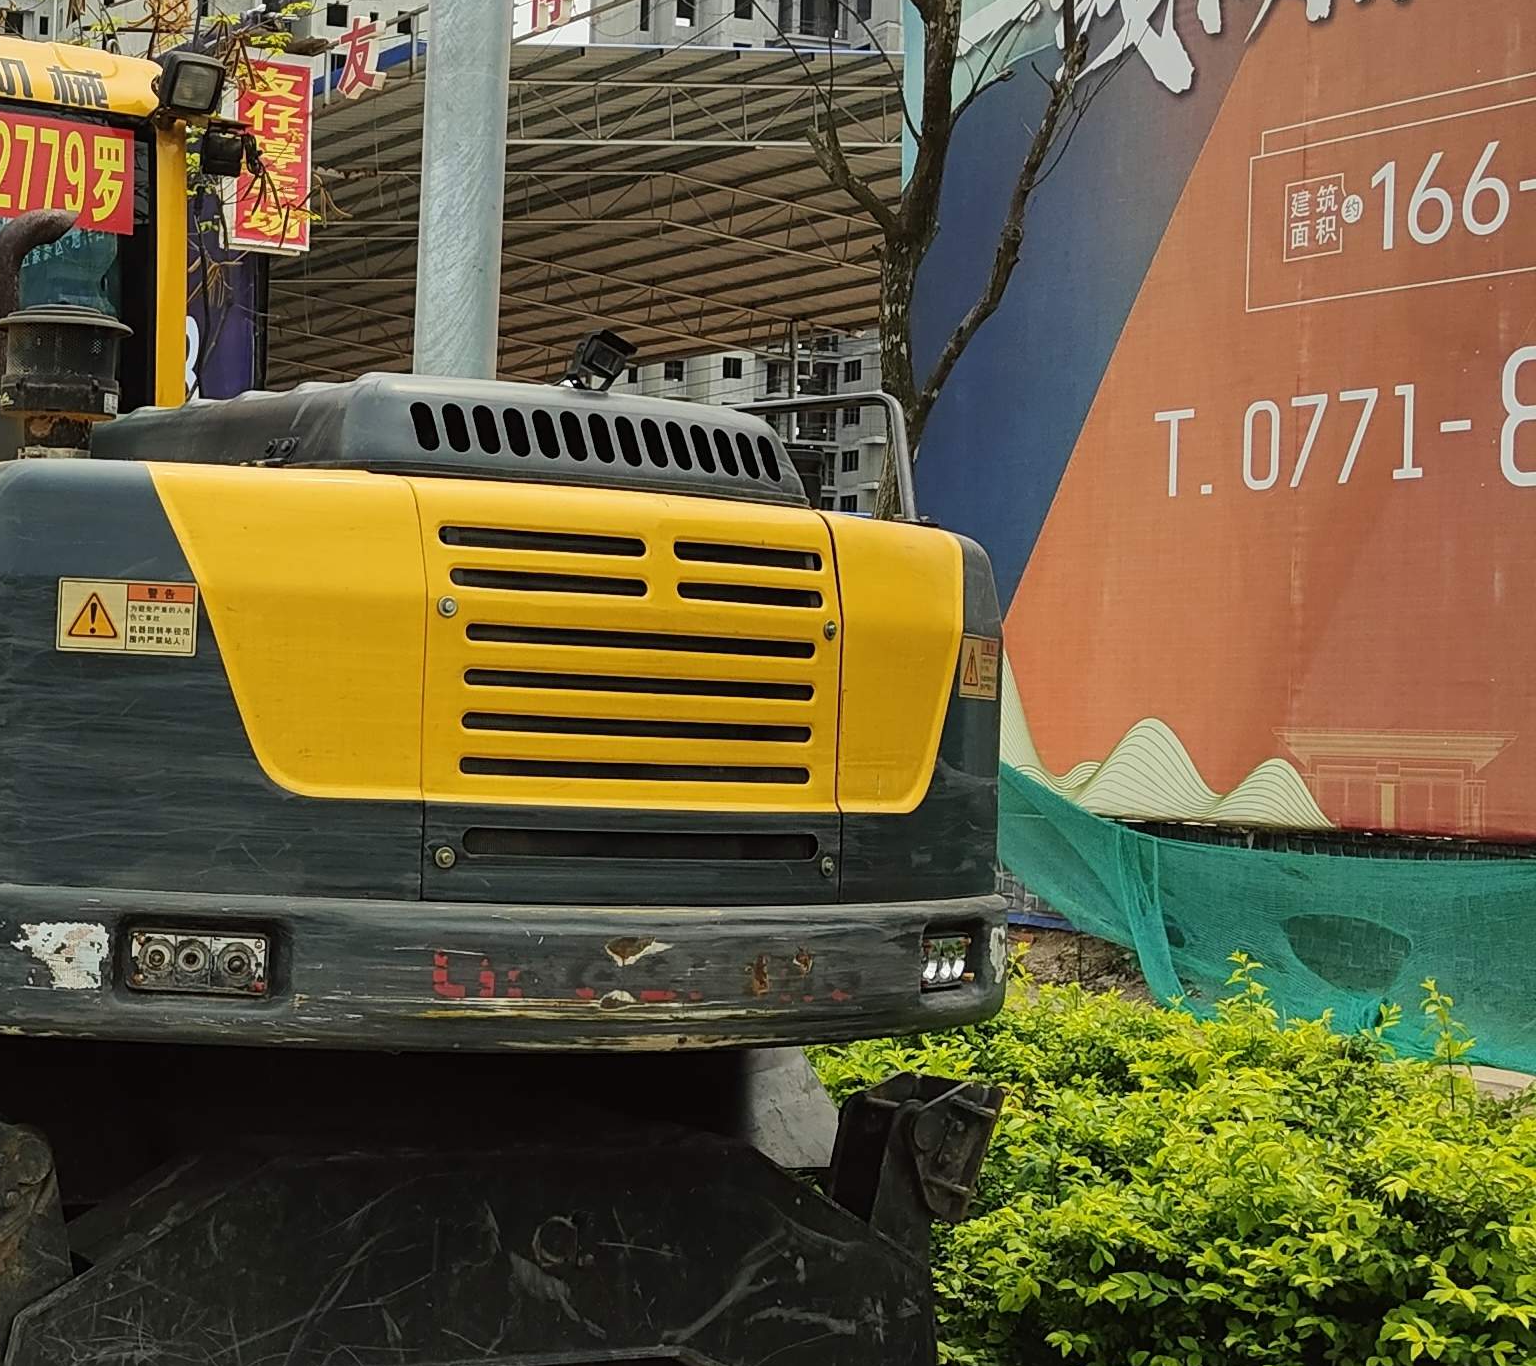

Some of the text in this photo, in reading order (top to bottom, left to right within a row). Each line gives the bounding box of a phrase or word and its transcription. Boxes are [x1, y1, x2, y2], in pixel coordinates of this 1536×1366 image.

[147, 587, 176, 600] 警告
[129, 604, 191, 614] 为避免严重的人身
[129, 625, 191, 636] 机器回转半径范
